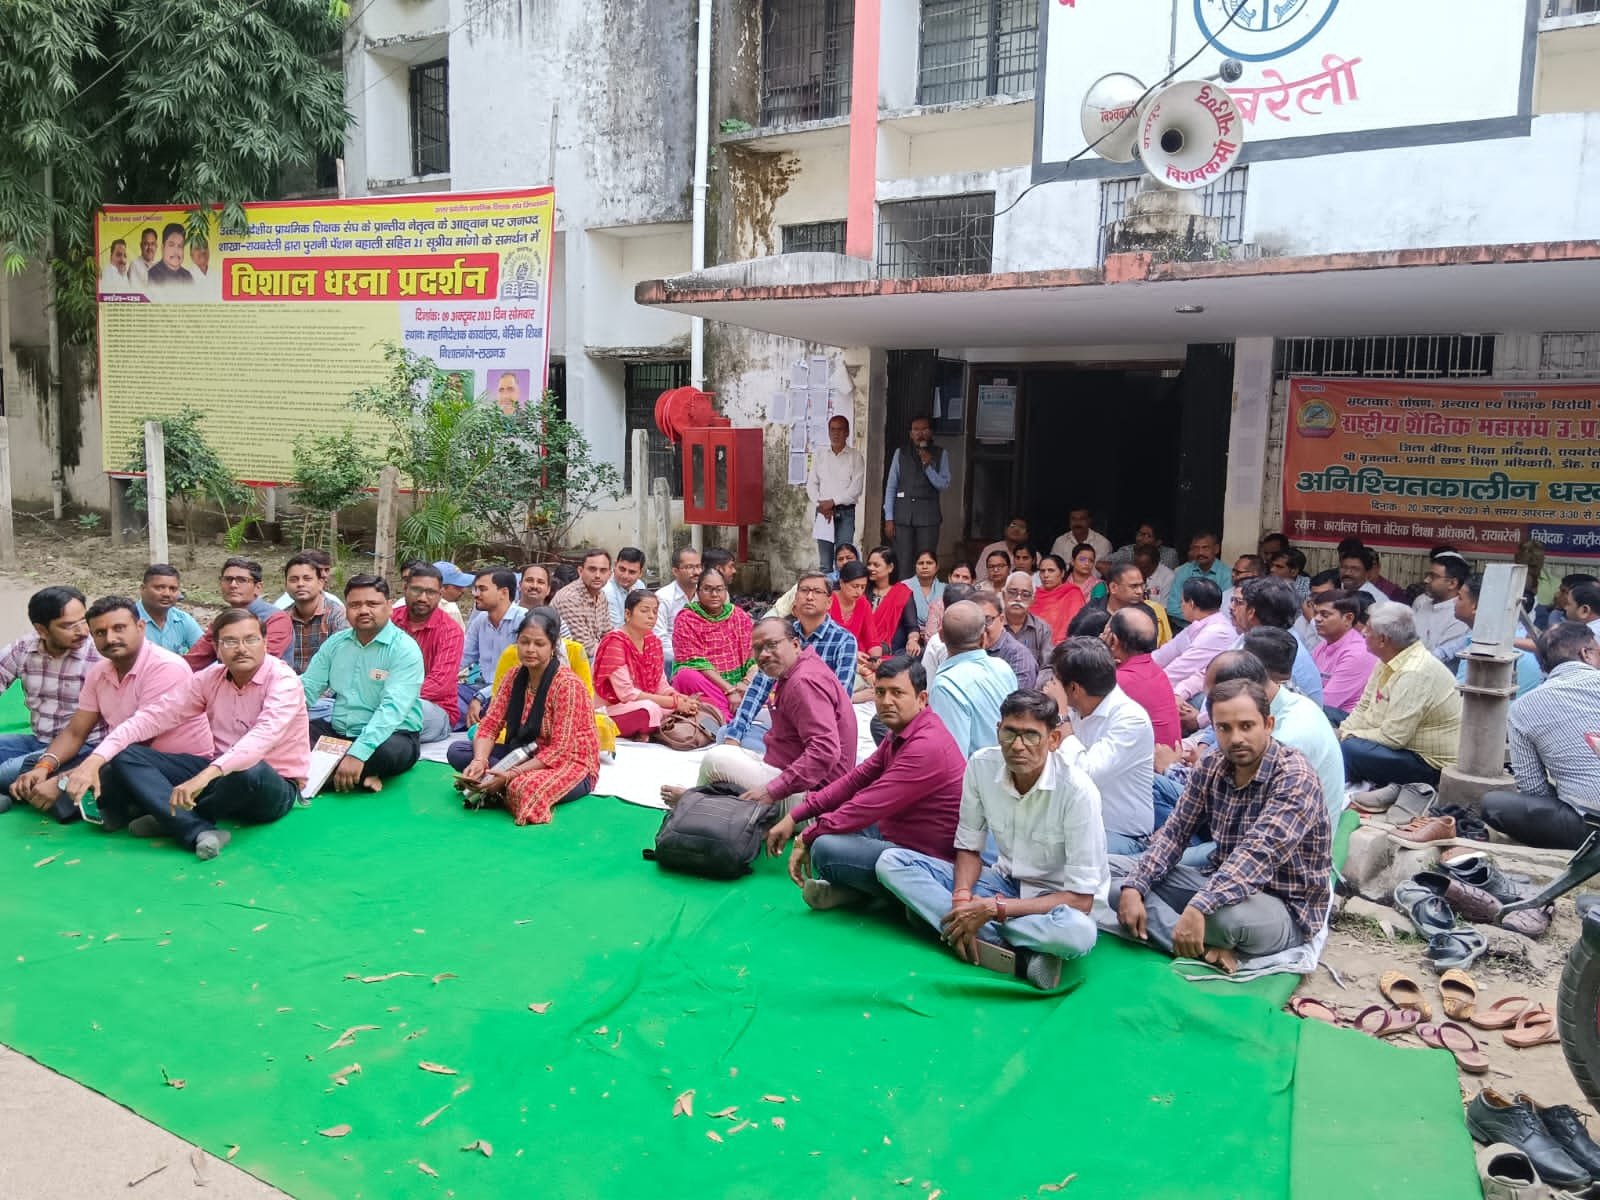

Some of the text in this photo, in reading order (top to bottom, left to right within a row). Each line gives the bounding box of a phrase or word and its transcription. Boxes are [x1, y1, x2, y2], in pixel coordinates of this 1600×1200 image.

[275, 221, 310, 235] प्राथमिक
[313, 220, 340, 233] शिक्षक
[343, 220, 359, 233] संघ
[361, 220, 373, 232] के
[437, 217, 449, 231] के
[491, 216, 505, 228] पर
[507, 214, 539, 228] जनपद
[303, 236, 328, 254] पुरानी
[386, 234, 411, 249] सहित
[481, 232, 492, 245] के
[495, 231, 528, 246] समर्थन
[530, 229, 541, 243] में
[231, 263, 318, 296] विशाल
[324, 268, 391, 296] धरना
[398, 258, 489, 296] प्रदर्शन
[493, 306, 507, 321] दिन
[508, 306, 536, 320] सोमवार
[1341, 410, 1402, 438] राष्ट्रीय
[1405, 411, 1472, 436] शैक्षिक
[1478, 414, 1551, 439] महासंघ
[1296, 465, 1541, 501] अनिश्चितकालीन
[1323, 518, 1358, 532] कार्यालय
[1360, 519, 1381, 534] जिला
